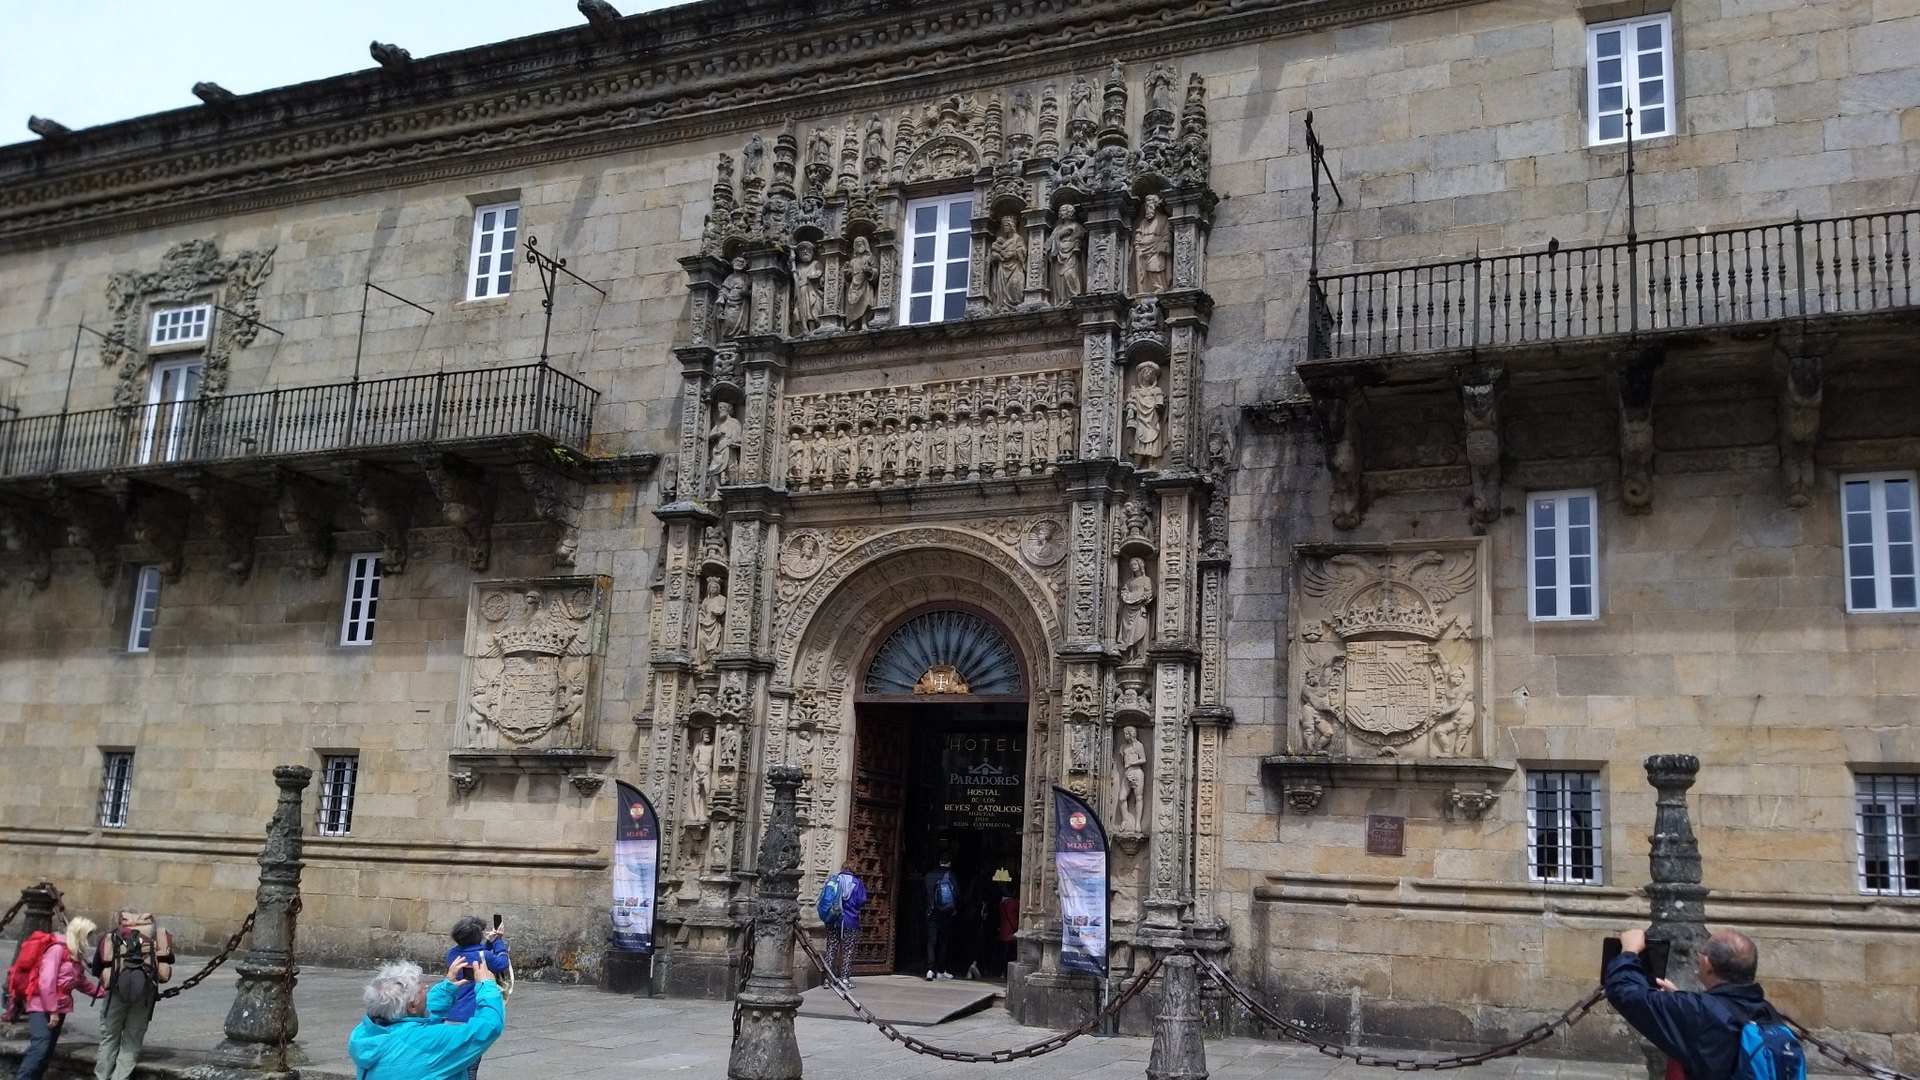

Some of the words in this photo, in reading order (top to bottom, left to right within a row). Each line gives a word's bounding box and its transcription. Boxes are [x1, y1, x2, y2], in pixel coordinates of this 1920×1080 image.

[950, 738, 1022, 751] HOTEL
[949, 773, 1020, 786] PARADORES
[967, 788, 1000, 796] HOSTAL
[944, 804, 971, 812] REYES
[977, 804, 1023, 813] CATOLICOS
